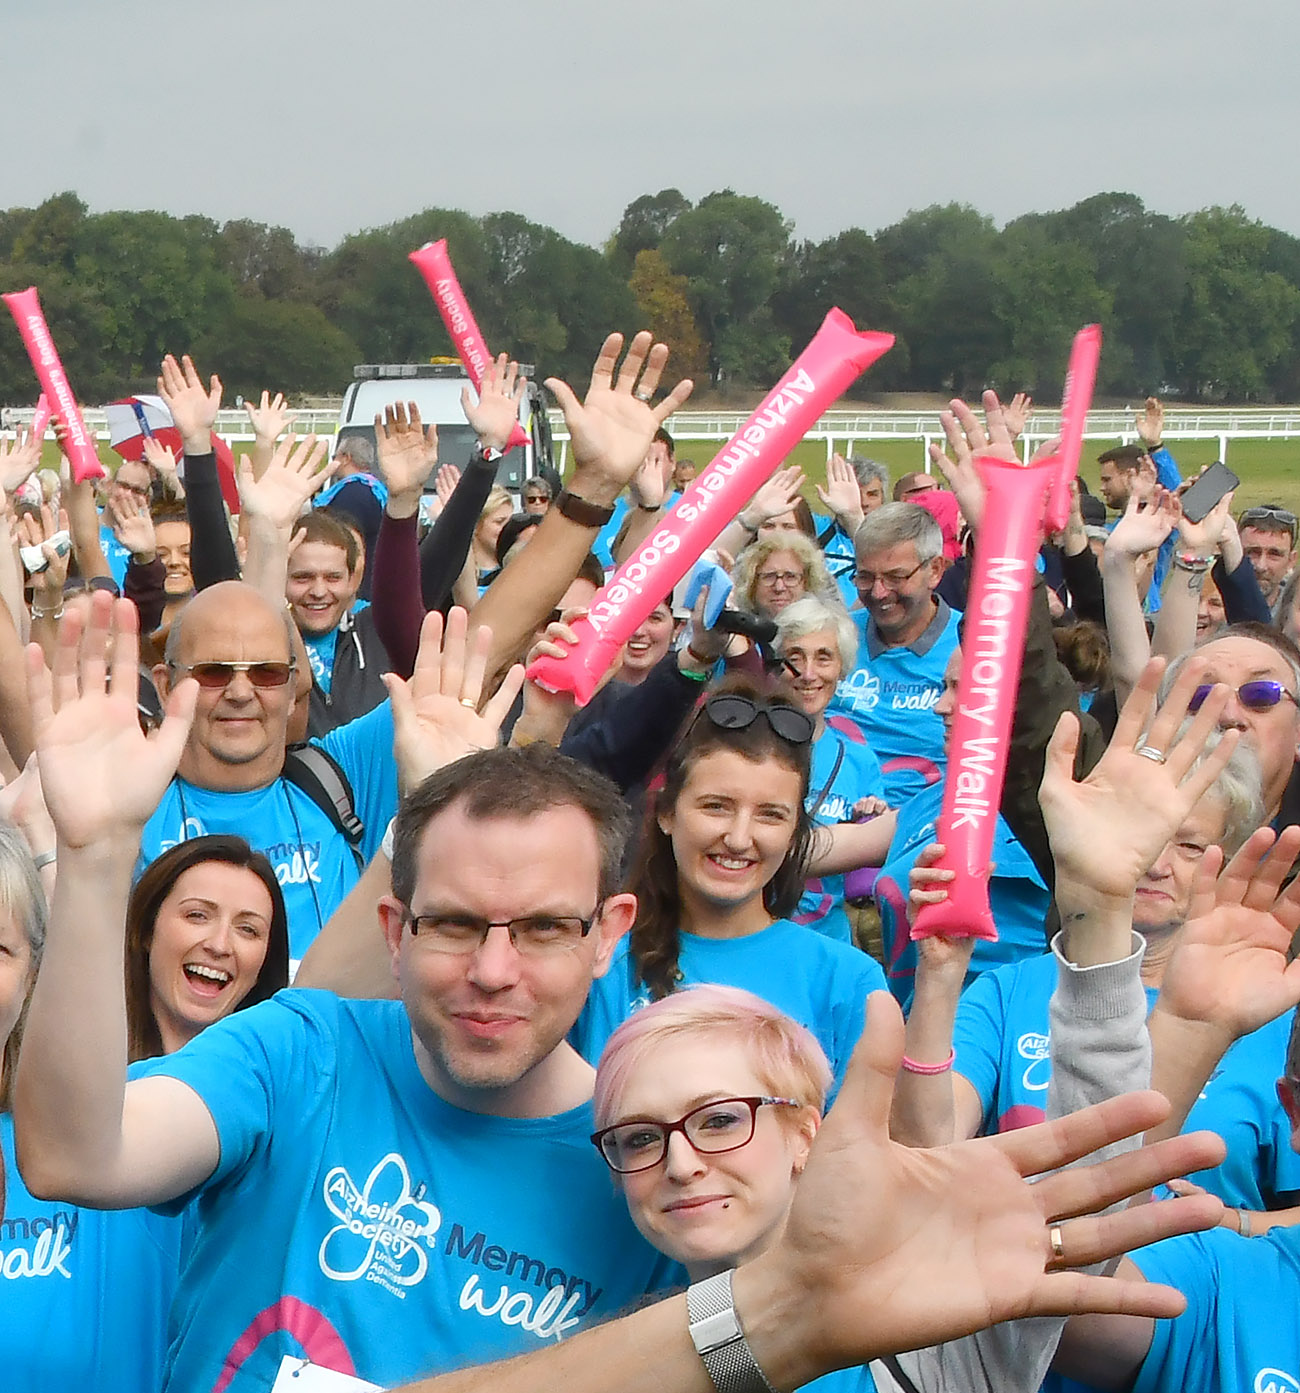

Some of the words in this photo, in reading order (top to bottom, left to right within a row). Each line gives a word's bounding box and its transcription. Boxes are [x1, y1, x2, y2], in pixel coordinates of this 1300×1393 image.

[676, 367, 815, 523] Alzheimer's
[587, 528, 681, 633] Society
[958, 557, 1026, 720] Memory
[950, 738, 995, 830] Walk
[273, 850, 322, 886] alk
[445, 1223, 603, 1317] Memory
[460, 1274, 580, 1342] walk
